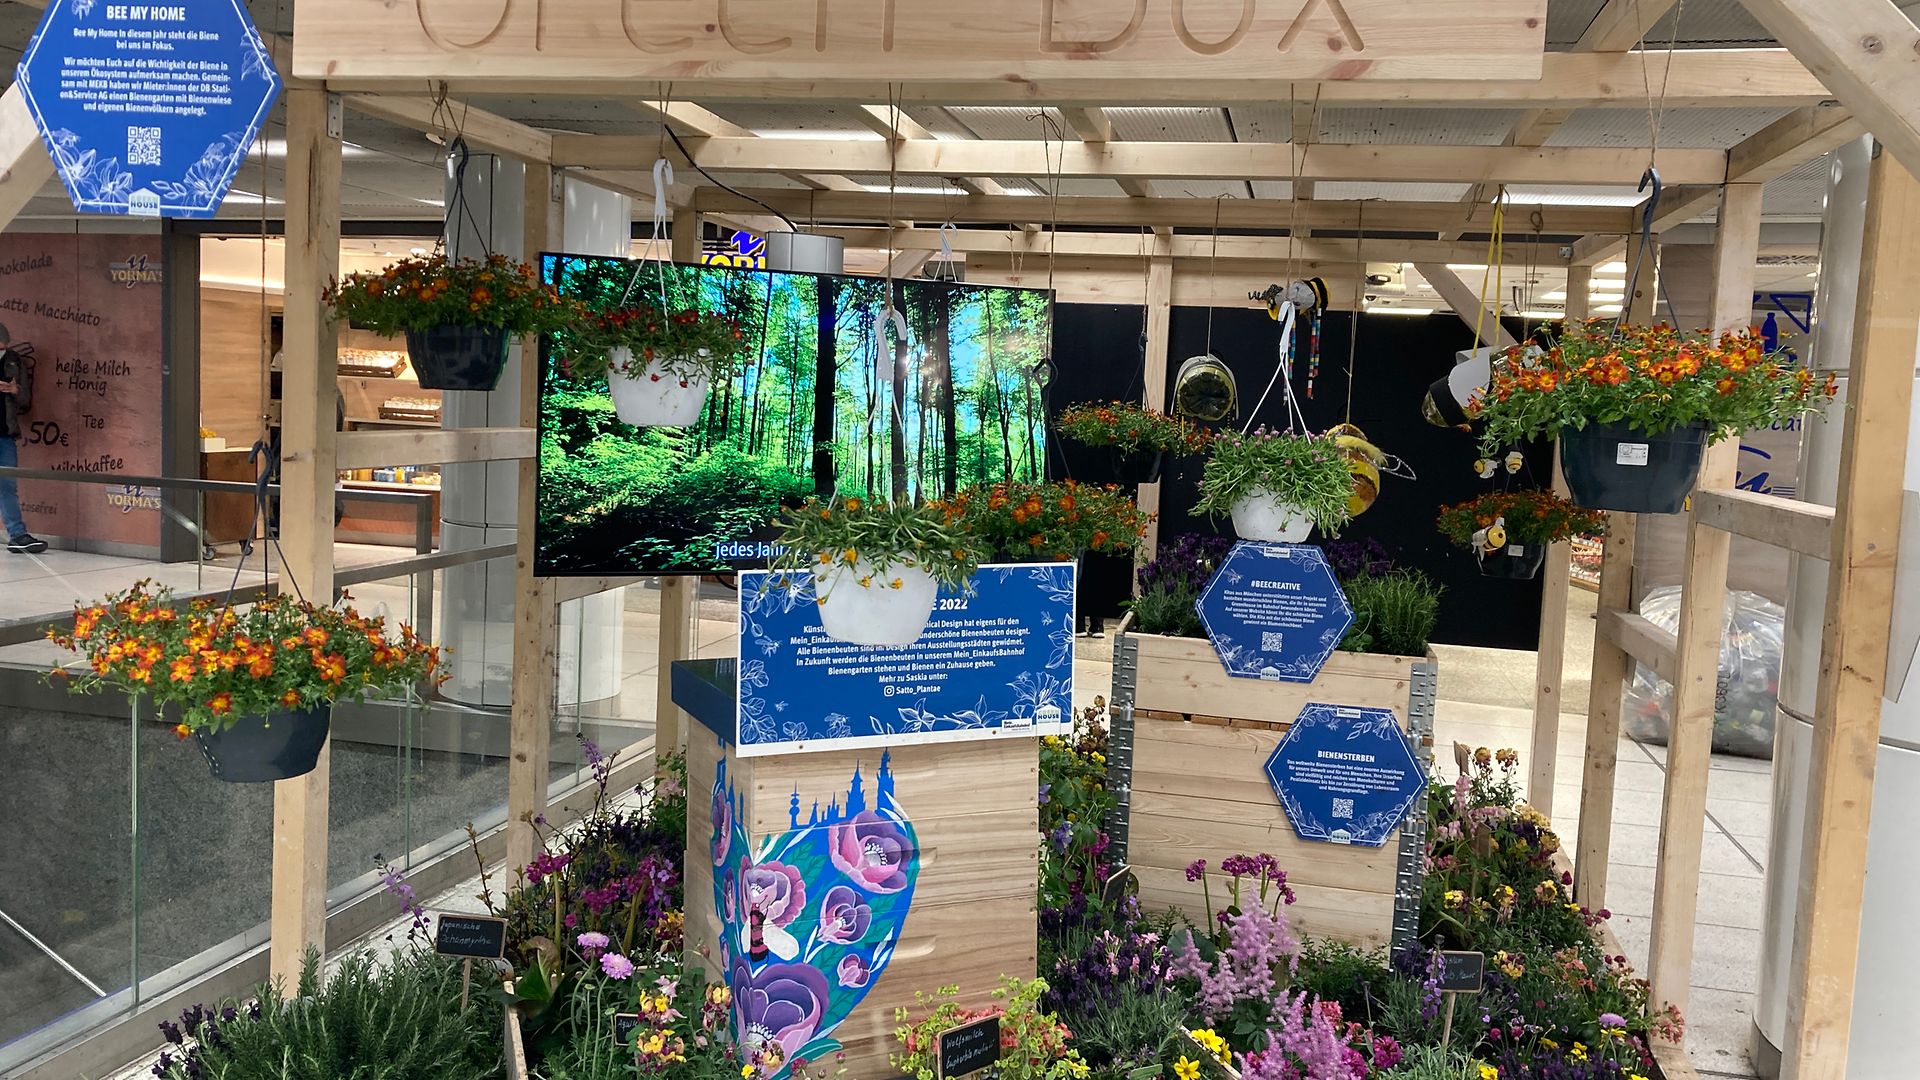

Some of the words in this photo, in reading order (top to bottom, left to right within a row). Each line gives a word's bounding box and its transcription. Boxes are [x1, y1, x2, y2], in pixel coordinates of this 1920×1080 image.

[106, 6, 128, 20] BEE
[130, 6, 148, 20] MY
[150, 6, 186, 20] HOME
[74, 28, 86, 37] Bee
[87, 28, 97, 39] My
[99, 28, 118, 37] Home
[127, 29, 151, 38] diesem
[153, 30, 167, 39] Jahr
[168, 31, 186, 40] steht
[186, 31, 198, 40] die
[199, 31, 219, 40] Biene
[116, 40, 127, 48] bei
[142, 41, 151, 50] im
[152, 41, 174, 50] Fokus.
[64, 57, 76, 66] Wir
[77, 57, 105, 67] möchten
[106, 58, 122, 68] Euch
[123, 59, 135, 68] auf
[136, 59, 146, 68] die
[147, 59, 186, 70] Wichtigkeit
[187, 60, 199, 70] der
[200, 61, 219, 70] Biene
[221, 62, 228, 70] in
[61, 69, 90, 77] unserem
[91, 67, 128, 80] Ökosystem
[128, 70, 170, 80] aufmerksam
[172, 71, 200, 80] machen.
[202, 72, 231, 81] Gemein-
[76, 79, 88, 88] mit
[89, 80, 108, 89] MEKB
[109, 80, 130, 90] haben
[131, 82, 142, 90] wir
[188, 83, 200, 92] der
[201, 83, 210, 92] DB
[98, 91, 108, 100] AG
[109, 92, 128, 100] einen
[129, 92, 174, 103] Bienengarten
[176, 94, 187, 102] mit
[188, 94, 232, 104] Bienenwiese
[83, 101, 97, 110] und
[98, 102, 125, 113] eigenen
[125, 102, 174, 113] Bienenvölkern
[175, 106, 207, 116] angelegt.
[34, 301, 100, 326] Macchiato
[55, 358, 89, 375] heiße
[94, 360, 131, 377] Milch
[68, 376, 108, 396] Honig
[82, 414, 104, 430] Tee
[716, 541, 754, 559] jedes
[1251, 580, 1301, 590] #BEECREATIVE
[940, 598, 968, 610] 2022
[941, 619, 962, 629] Design
[964, 618, 975, 627] hat
[976, 618, 996, 628] eigens
[997, 618, 1007, 626] für
[1006, 628, 1030, 636] designt.
[797, 647, 810, 655] Alle
[812, 645, 858, 655] Bienenbeuten
[992, 638, 1024, 647] gewidmet.
[796, 658, 804, 666] In
[805, 657, 831, 665] Zukunft
[832, 656, 856, 664] werden
[870, 653, 915, 662] Bienenbeuten
[828, 667, 872, 675] Bienengarten
[874, 665, 896, 673] stehen
[974, 660, 996, 669] geben.
[906, 673, 927, 681] Saskia
[929, 672, 948, 680] unter:
[896, 685, 940, 694] Satto_Plantae
[1318, 751, 1375, 762] BIENENSTERBEN
